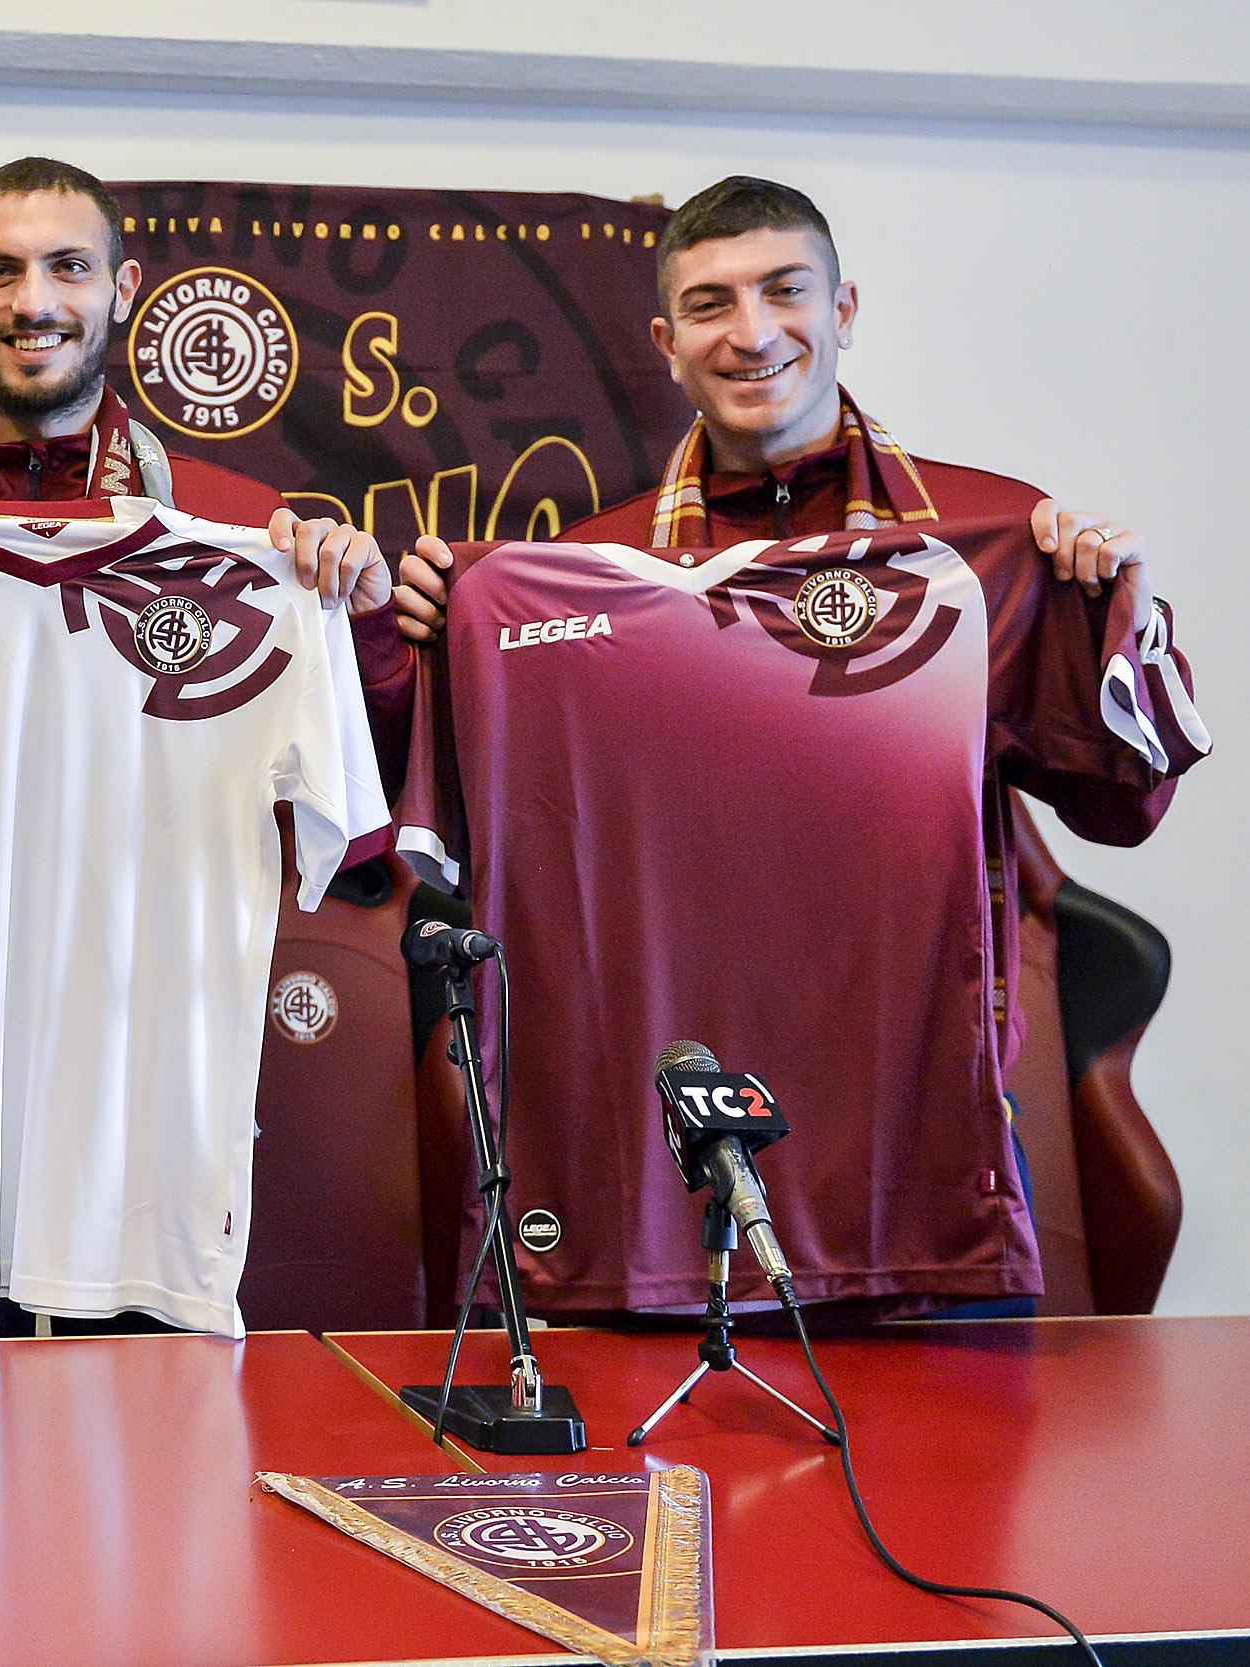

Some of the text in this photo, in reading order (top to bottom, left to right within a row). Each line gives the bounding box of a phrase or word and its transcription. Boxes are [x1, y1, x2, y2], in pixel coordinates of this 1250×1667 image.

[123, 216, 223, 234] RTIVA
[252, 219, 401, 241] LIVORNO
[428, 223, 551, 241] CALCIO
[137, 277, 289, 401] A.S. LIVORNO CALCIO
[182, 403, 240, 428] 1915
[802, 570, 851, 596] LIVORNO
[854, 577, 877, 617] CALCIO
[144, 598, 193, 617] LIVORNO
[194, 609, 210, 650] CALCIO
[498, 612, 612, 652] LEGEA
[680, 1085, 773, 1119] TC2
[433, 1472, 544, 1488] Livorno
[555, 1473, 646, 1488] Calcio
[450, 1509, 545, 1528] LIVORNO
[556, 1512, 627, 1540] CALCIO
[526, 1555, 588, 1567] 1915
